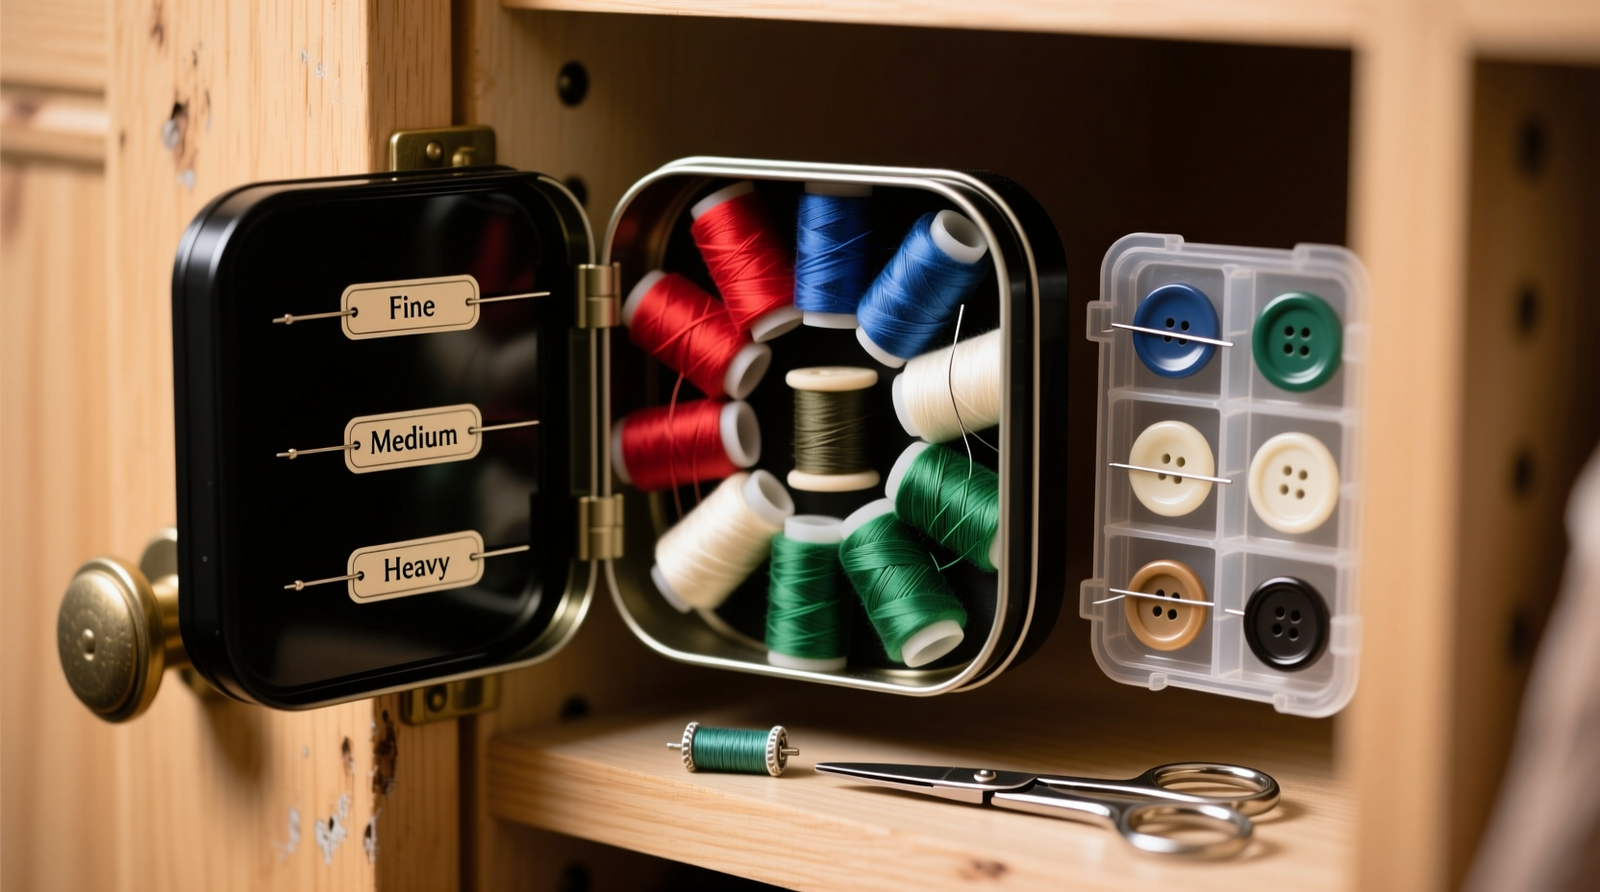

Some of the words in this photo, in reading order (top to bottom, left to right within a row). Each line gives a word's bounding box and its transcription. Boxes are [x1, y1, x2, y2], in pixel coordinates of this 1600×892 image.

[389, 295, 436, 320] Fine
[370, 425, 458, 455] Medium
[384, 556, 450, 582] Heavy
